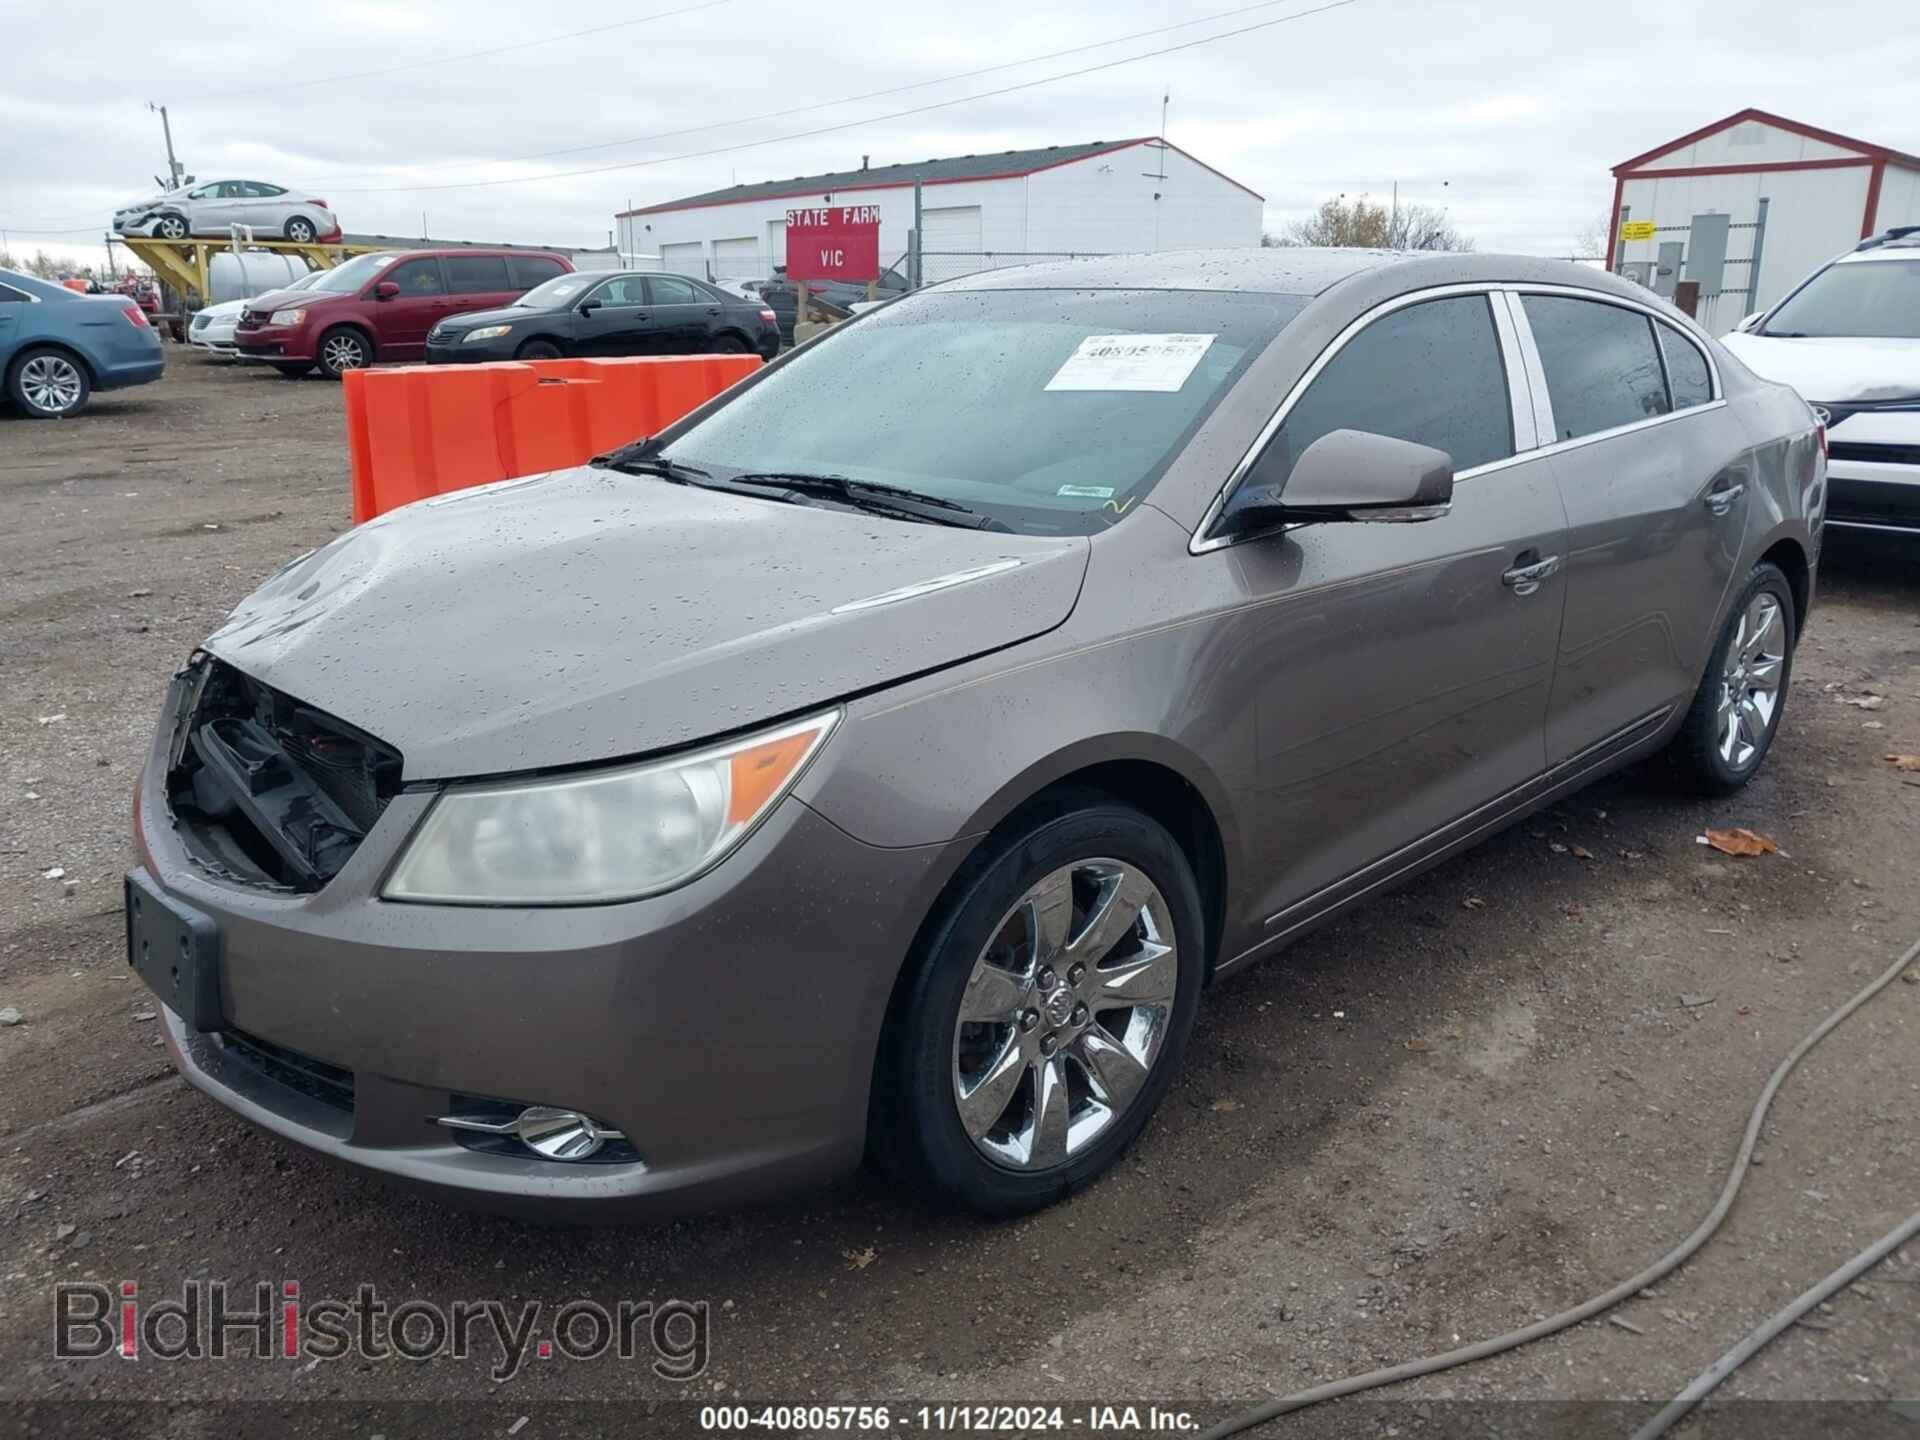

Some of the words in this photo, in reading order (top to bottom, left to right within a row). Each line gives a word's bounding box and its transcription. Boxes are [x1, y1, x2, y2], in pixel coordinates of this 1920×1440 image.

[787, 209, 829, 227] STATE
[843, 207, 880, 224] FARM
[821, 250, 844, 267] VIC
